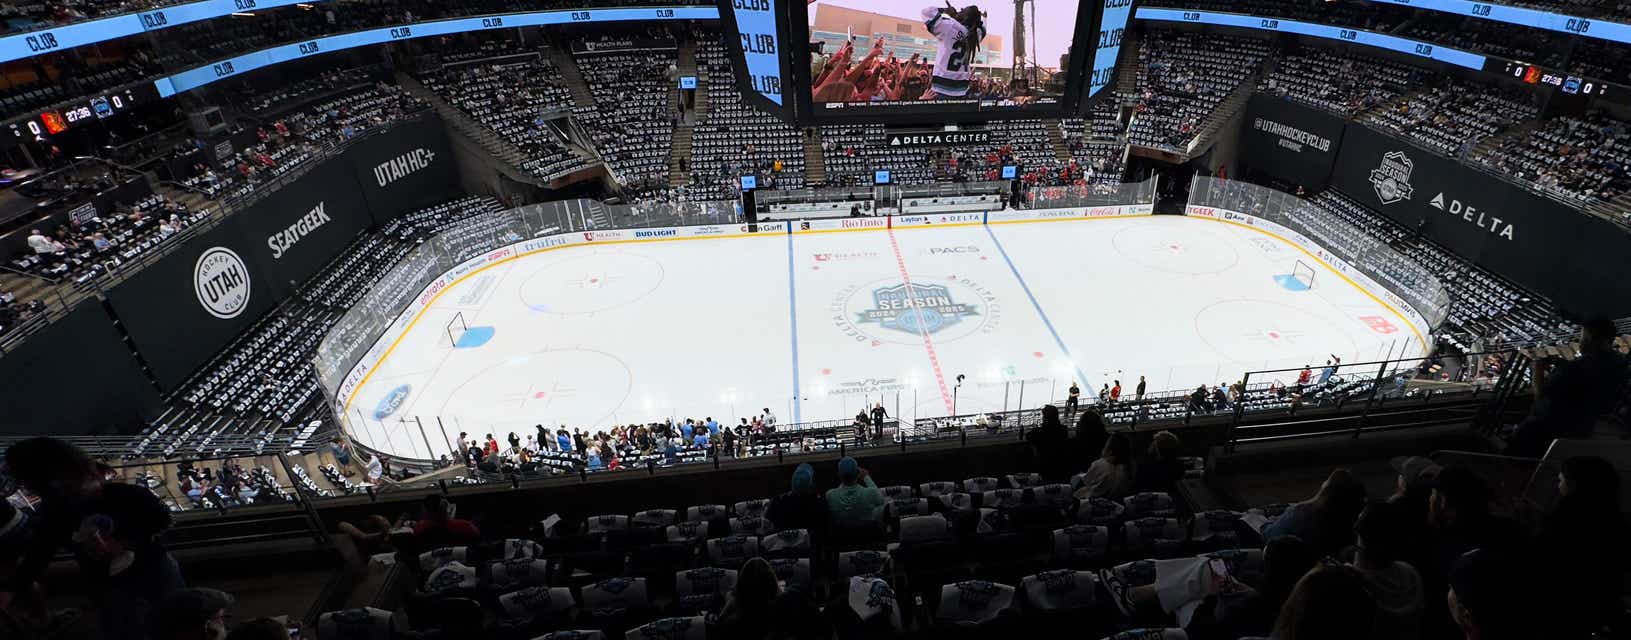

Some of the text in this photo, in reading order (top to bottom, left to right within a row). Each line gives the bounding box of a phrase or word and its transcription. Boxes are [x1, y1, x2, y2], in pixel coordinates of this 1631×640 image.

[236, 0, 256, 9] CLUB
[1472, 4, 1492, 16] CLUB
[145, 12, 167, 27] CLUB
[572, 12, 590, 21] CLUB
[657, 9, 674, 18] CLUB
[1184, 12, 1200, 21] CLUB
[483, 18, 503, 28] CLUB
[1261, 19, 1278, 29] CLUB
[1565, 18, 1590, 33] CLUB
[391, 27, 411, 39] CLUB
[1340, 30, 1357, 40] CLUB
[25, 32, 58, 52] CLUB
[299, 42, 319, 55] CLUB
[740, 33, 775, 54] CLUB
[1415, 44, 1432, 56] CLUB
[214, 61, 235, 77] CLUB
[1514, 66, 1523, 77] 0
[1090, 67, 1113, 87] CLU
[753, 74, 781, 95] LUB
[1583, 83, 1593, 94] 0
[112, 96, 123, 109] 0
[28, 121, 40, 135] 0
[1254, 117, 1331, 152] @UTAHHOCKEYCLUB
[903, 133, 988, 144] DELTA CENTER
[1449, 199, 1513, 240] DELTA
[268, 201, 331, 259] SEATGEEK
[653, 229, 676, 237] LIGHT
[930, 245, 980, 255] PACS
[202, 255, 229, 277] HOCKEY
[1323, 253, 1347, 272] DELTA
[203, 264, 243, 303] UTAH
[224, 294, 242, 311] CLUB
[880, 297, 952, 310] SEASON
[344, 364, 368, 393] DELTA
